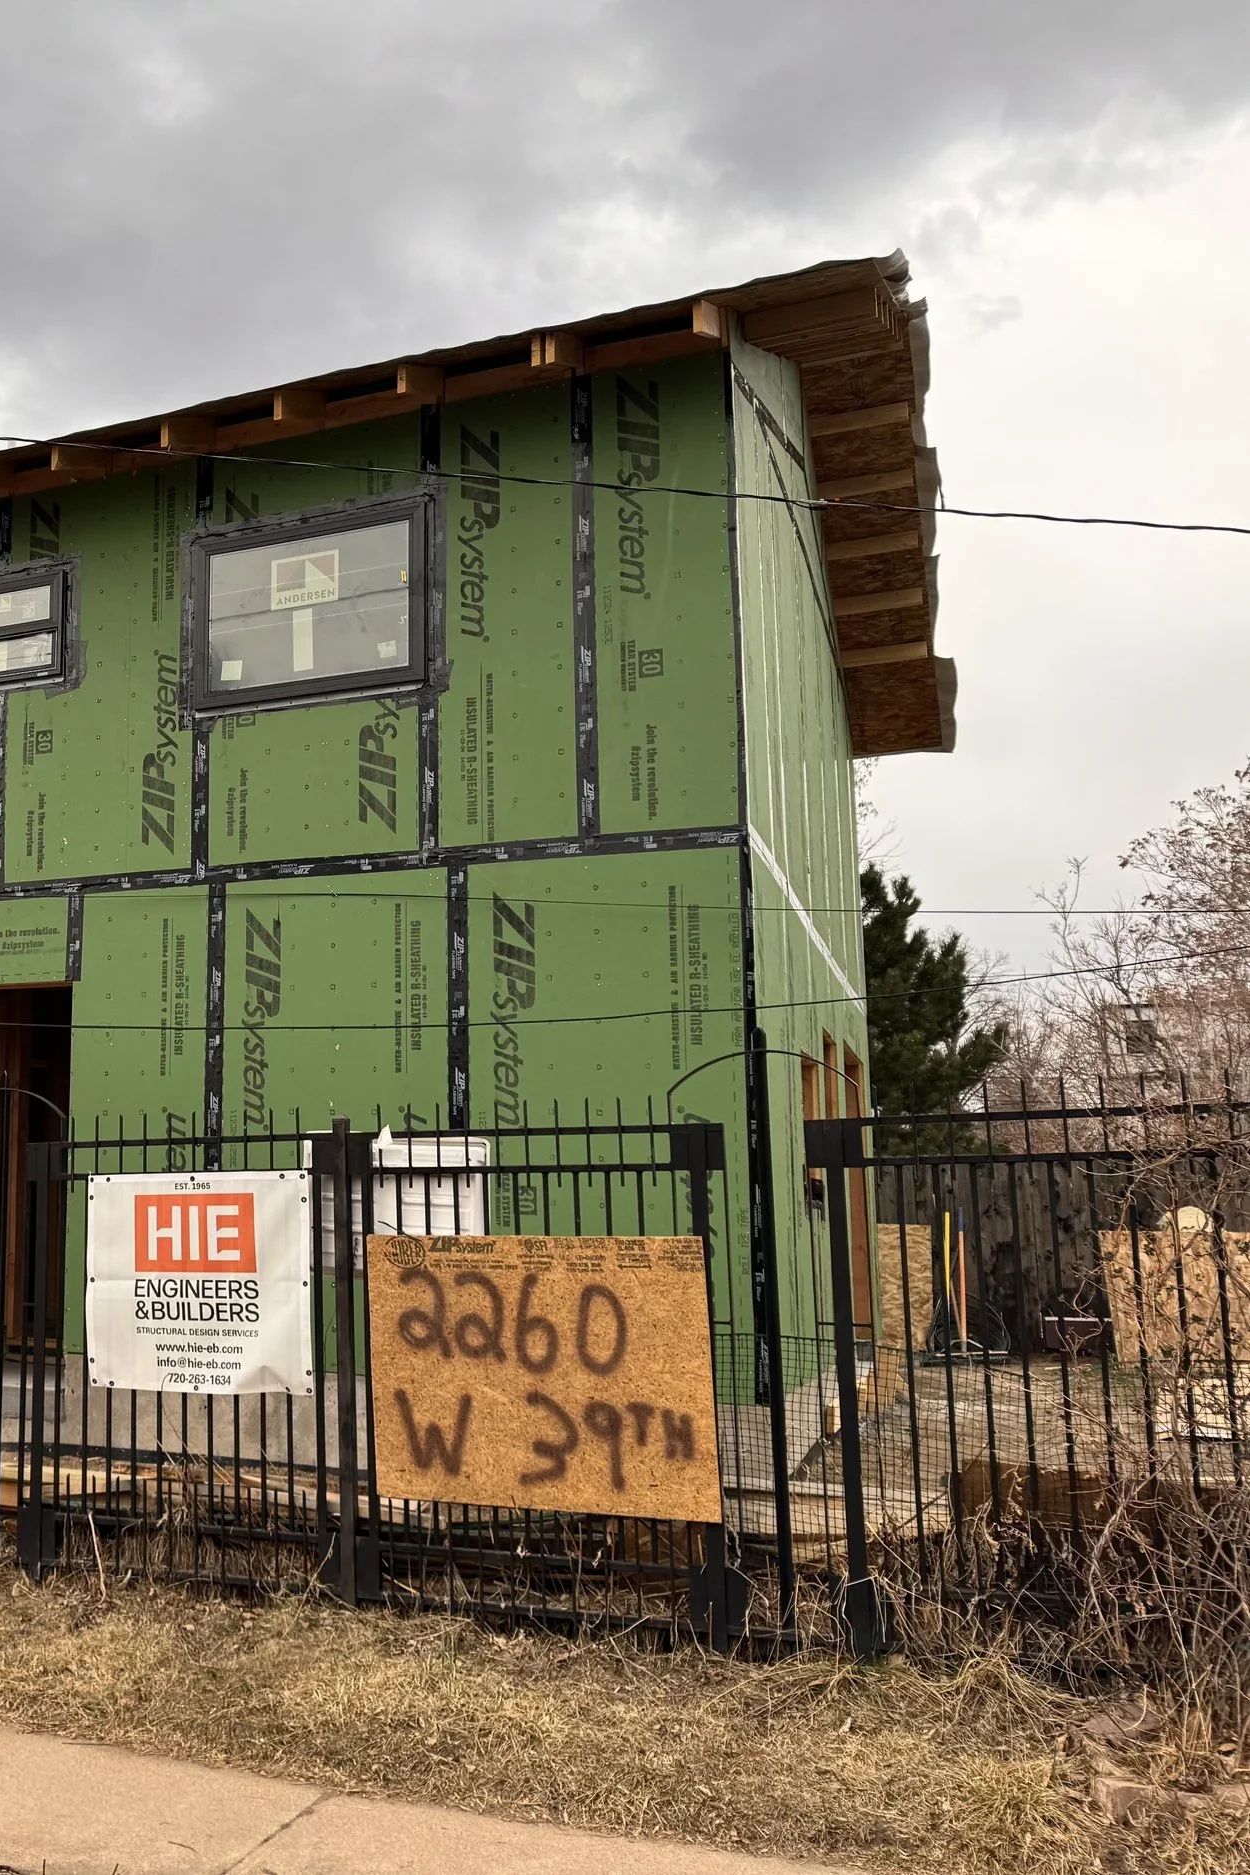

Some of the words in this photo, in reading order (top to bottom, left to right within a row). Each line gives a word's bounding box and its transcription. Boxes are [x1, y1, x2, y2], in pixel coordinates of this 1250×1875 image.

[616, 371, 661, 600] ZIPsystem
[460, 422, 501, 643] ZIPsystem
[276, 588, 335, 606] ANDERSEN
[626, 640, 637, 660] YEAR
[626, 662, 636, 692] SYSTEM
[466, 697, 478, 752] INSULATED
[645, 723, 657, 745] Join
[141, 650, 178, 855] ZIPsystem
[646, 748, 658, 763] the
[239, 768, 249, 787] Join
[466, 756, 478, 826] R-SHEATHING
[647, 767, 659, 821] revolution.
[38, 792, 47, 810] Join
[239, 790, 249, 804] the
[37, 812, 46, 825] the
[238, 806, 248, 854] revolution.
[668, 885, 677, 931] PROTECTION
[4, 928, 18, 938] the
[19, 927, 60, 937] revolution.
[687, 904, 701, 979] R-SHEATHING
[175, 934, 186, 1000] R-SHEATHING
[410, 920, 421, 990] R-SHEATHING
[669, 934, 678, 967] BARRIER
[670, 971, 678, 985] AIR
[245, 908, 282, 1133] ZIPsystem
[690, 984, 703, 1046] INSULATED
[733, 987, 742, 1022] APICAR
[410, 993, 422, 1051] INSULATED
[669, 1002, 681, 1070] WATER-RESISTIVE
[192, 1182, 211, 1190] 1965
[147, 1204, 241, 1261] HIE
[134, 1279, 259, 1299] ENGINEERS
[135, 1301, 260, 1322] &BUILDERS
[397, 1267, 628, 1376] 2260
[136, 1326, 187, 1336] STRUCTURAL
[189, 1328, 219, 1337] DESIGN
[222, 1329, 259, 1338] SERVICES
[155, 1342, 243, 1354] www.hie-eb.com
[157, 1357, 241, 1370] info@hie-eb.com
[168, 1372, 231, 1385] 720-263-1634
[393, 1388, 473, 1476] W
